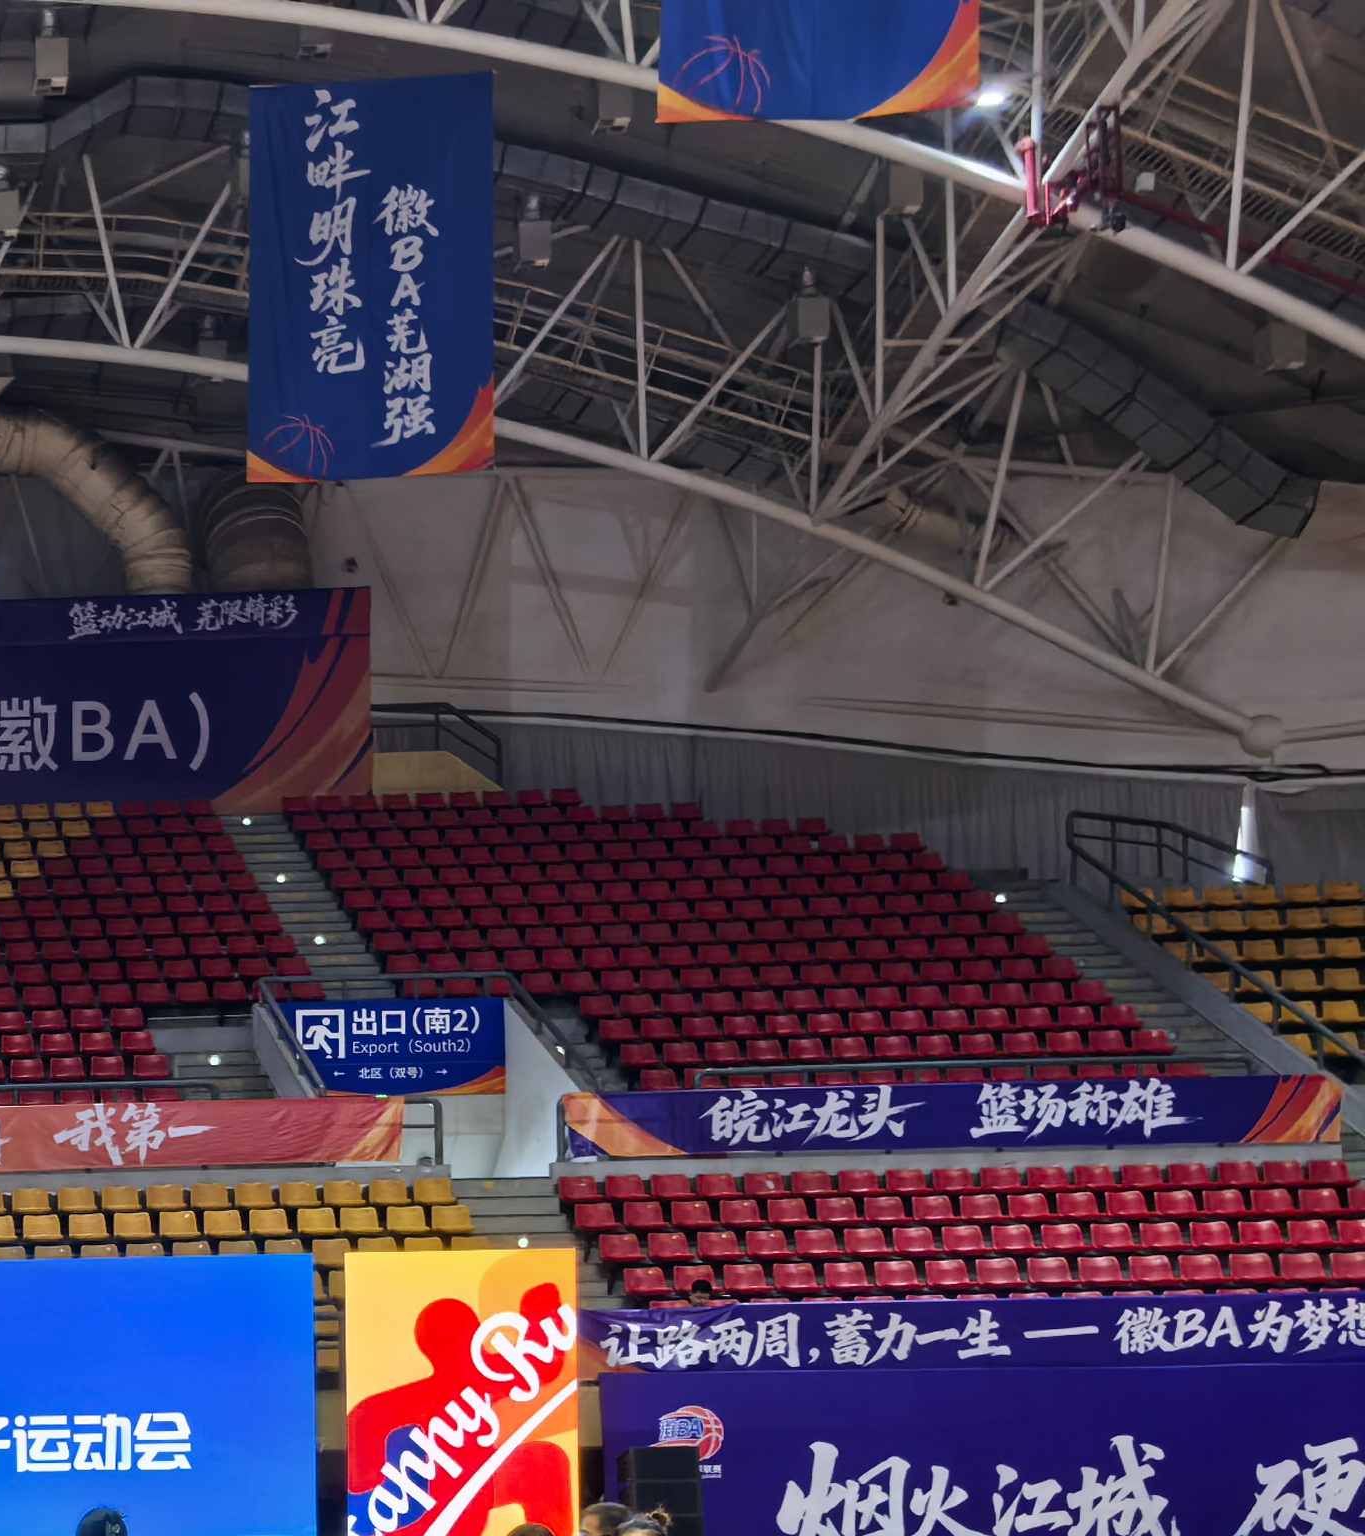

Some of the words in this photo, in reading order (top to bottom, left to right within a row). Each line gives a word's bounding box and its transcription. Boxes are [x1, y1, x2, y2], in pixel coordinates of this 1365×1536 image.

[294, 88, 372, 376] 江畔明珠亮
[352, 1040, 400, 1056] Export
[53, 1102, 218, 1167] 我第一
[700, 1085, 926, 1147] 皖江龙头
[970, 1077, 1203, 1141] 篮场称雄
